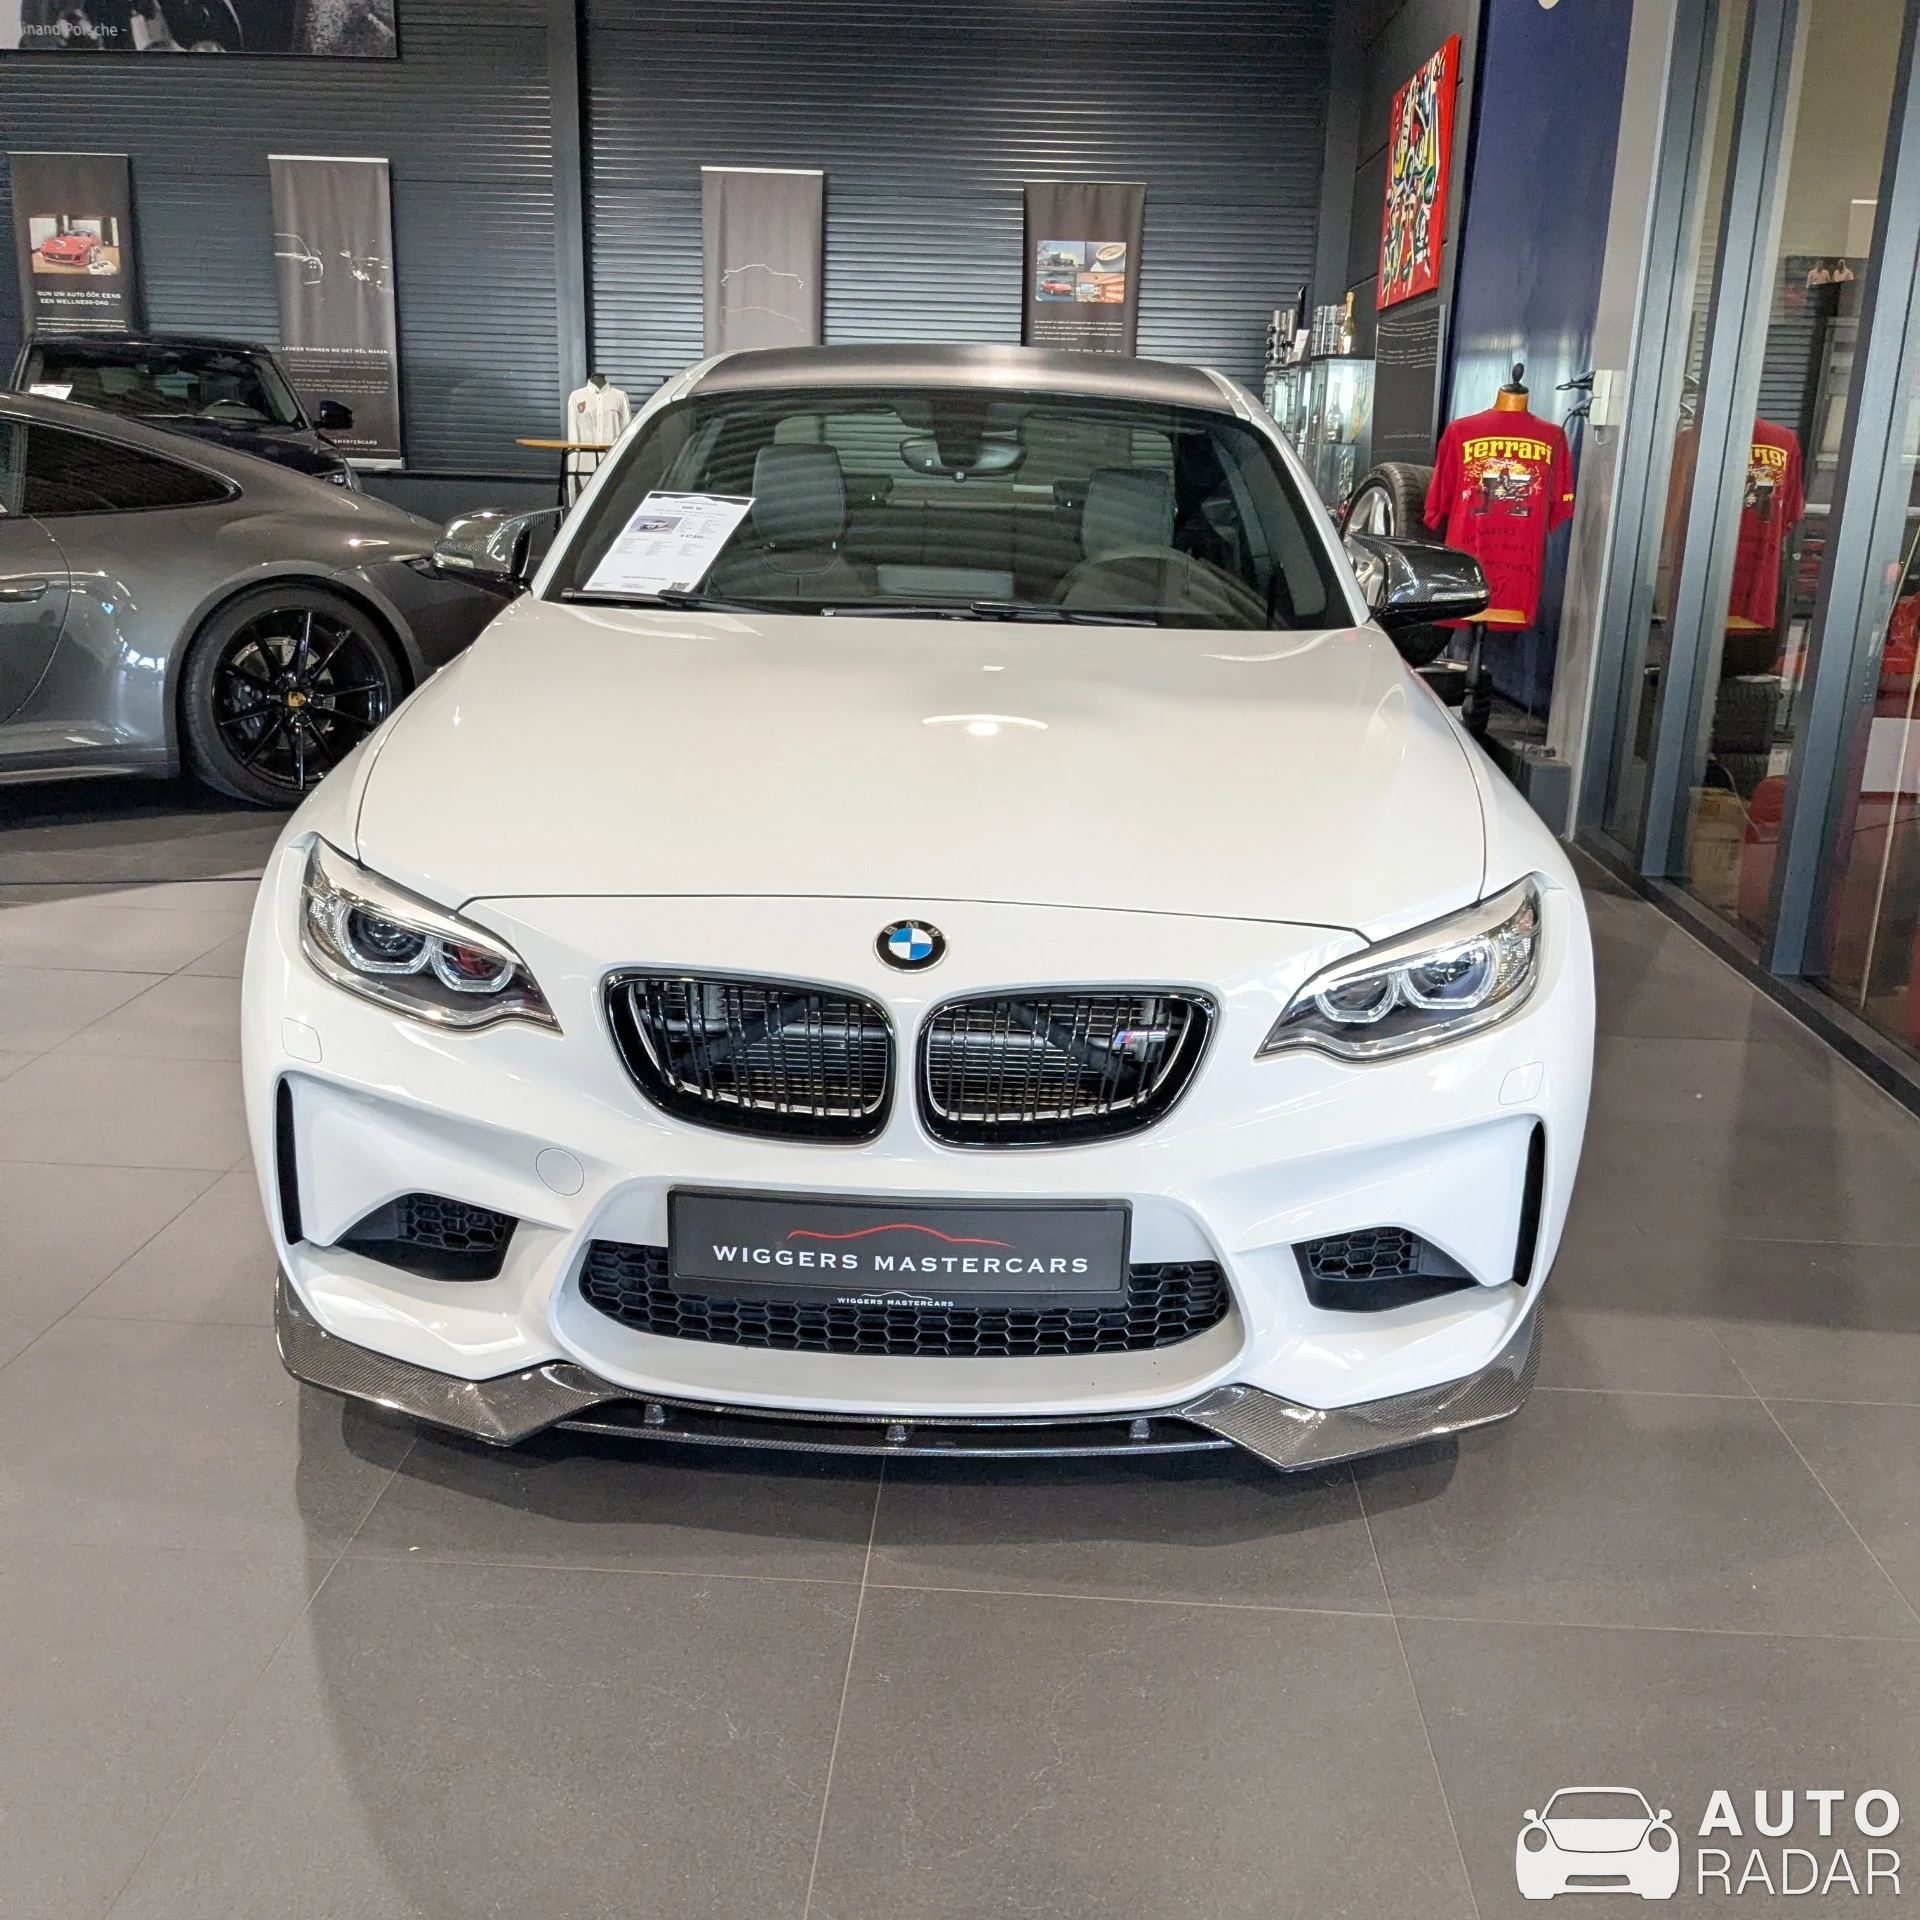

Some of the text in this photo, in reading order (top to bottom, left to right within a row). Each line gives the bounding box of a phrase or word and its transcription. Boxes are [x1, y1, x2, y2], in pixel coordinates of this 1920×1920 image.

[21, 21, 61, 36] inand
[1463, 437, 1553, 465] Ferrari
[883, 920, 943, 938] BMW
[712, 1245, 1088, 1274] WIGGERS MASTERCARS
[837, 1297, 954, 1307] WIGGERS MASTERCARS
